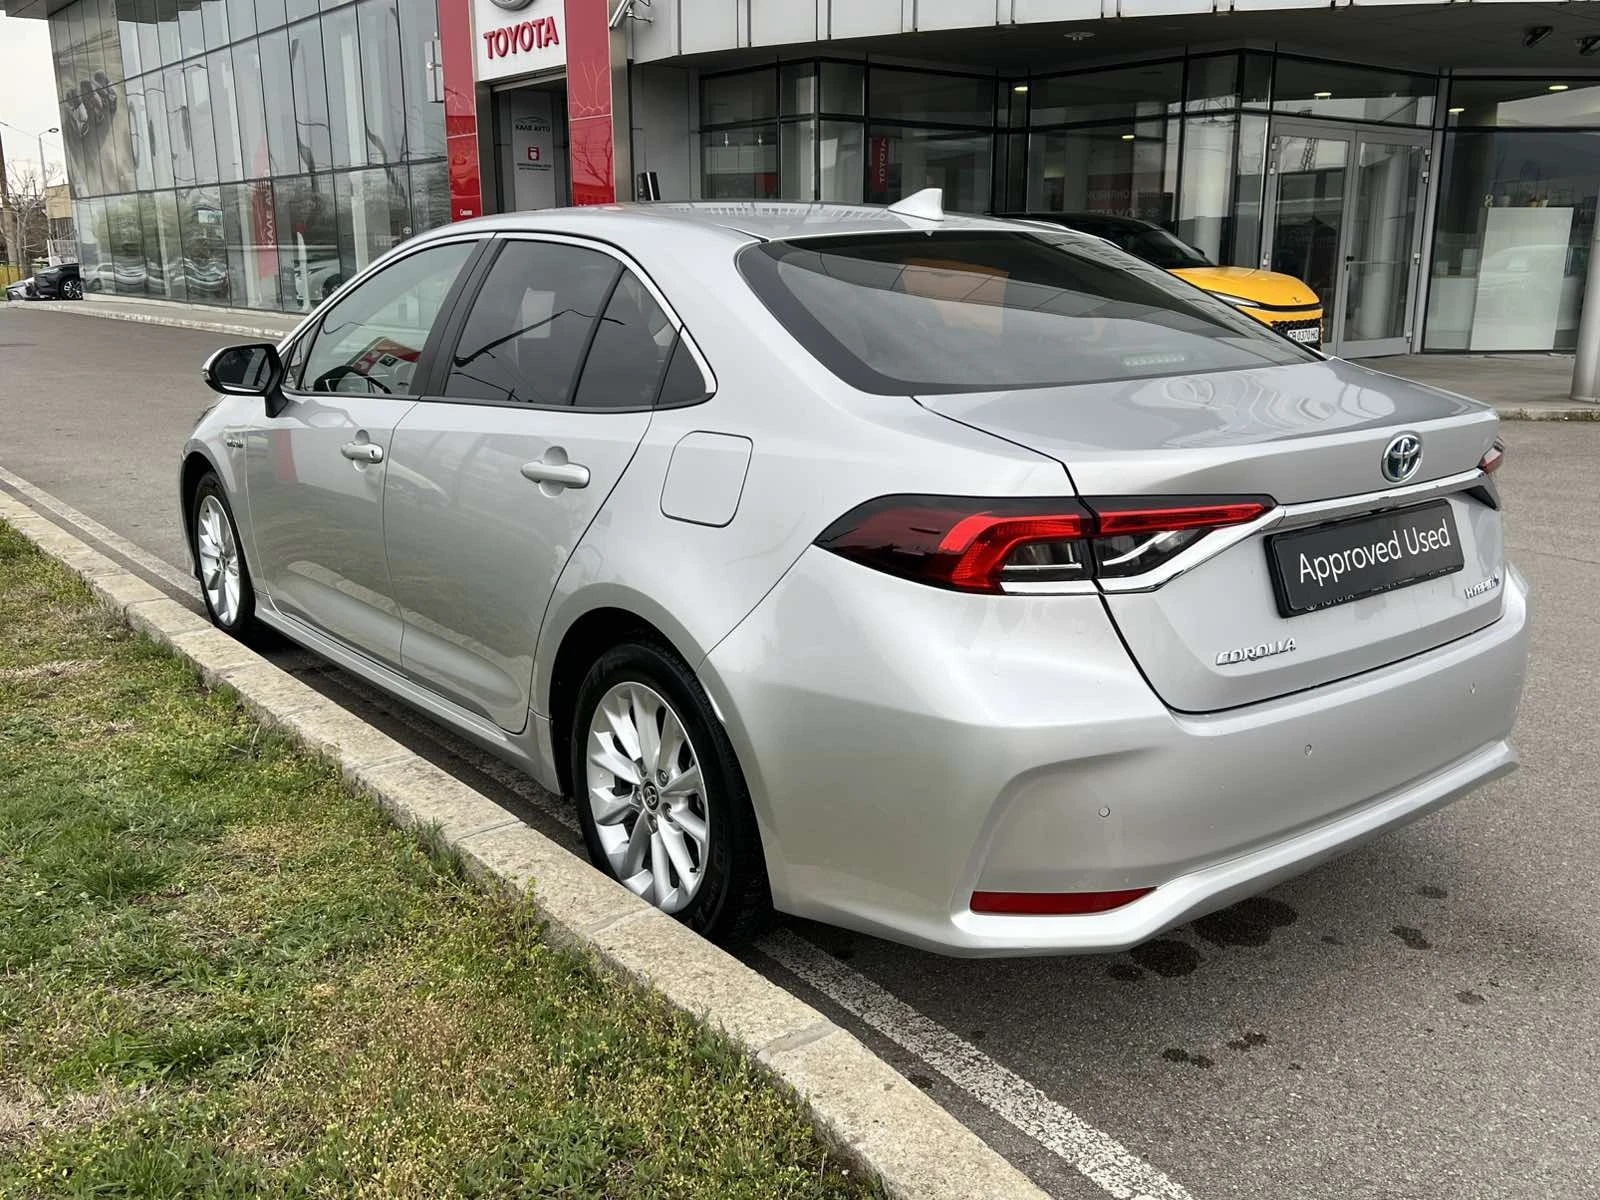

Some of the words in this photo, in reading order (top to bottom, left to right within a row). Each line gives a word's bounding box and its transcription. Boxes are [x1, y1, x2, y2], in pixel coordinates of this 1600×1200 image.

[483, 16, 559, 60] TOYOTA
[879, 137, 887, 184] TOYOTA
[1300, 529, 1402, 587] Approved
[1403, 518, 1451, 556] Used
[1216, 638, 1296, 666] COROLLA
